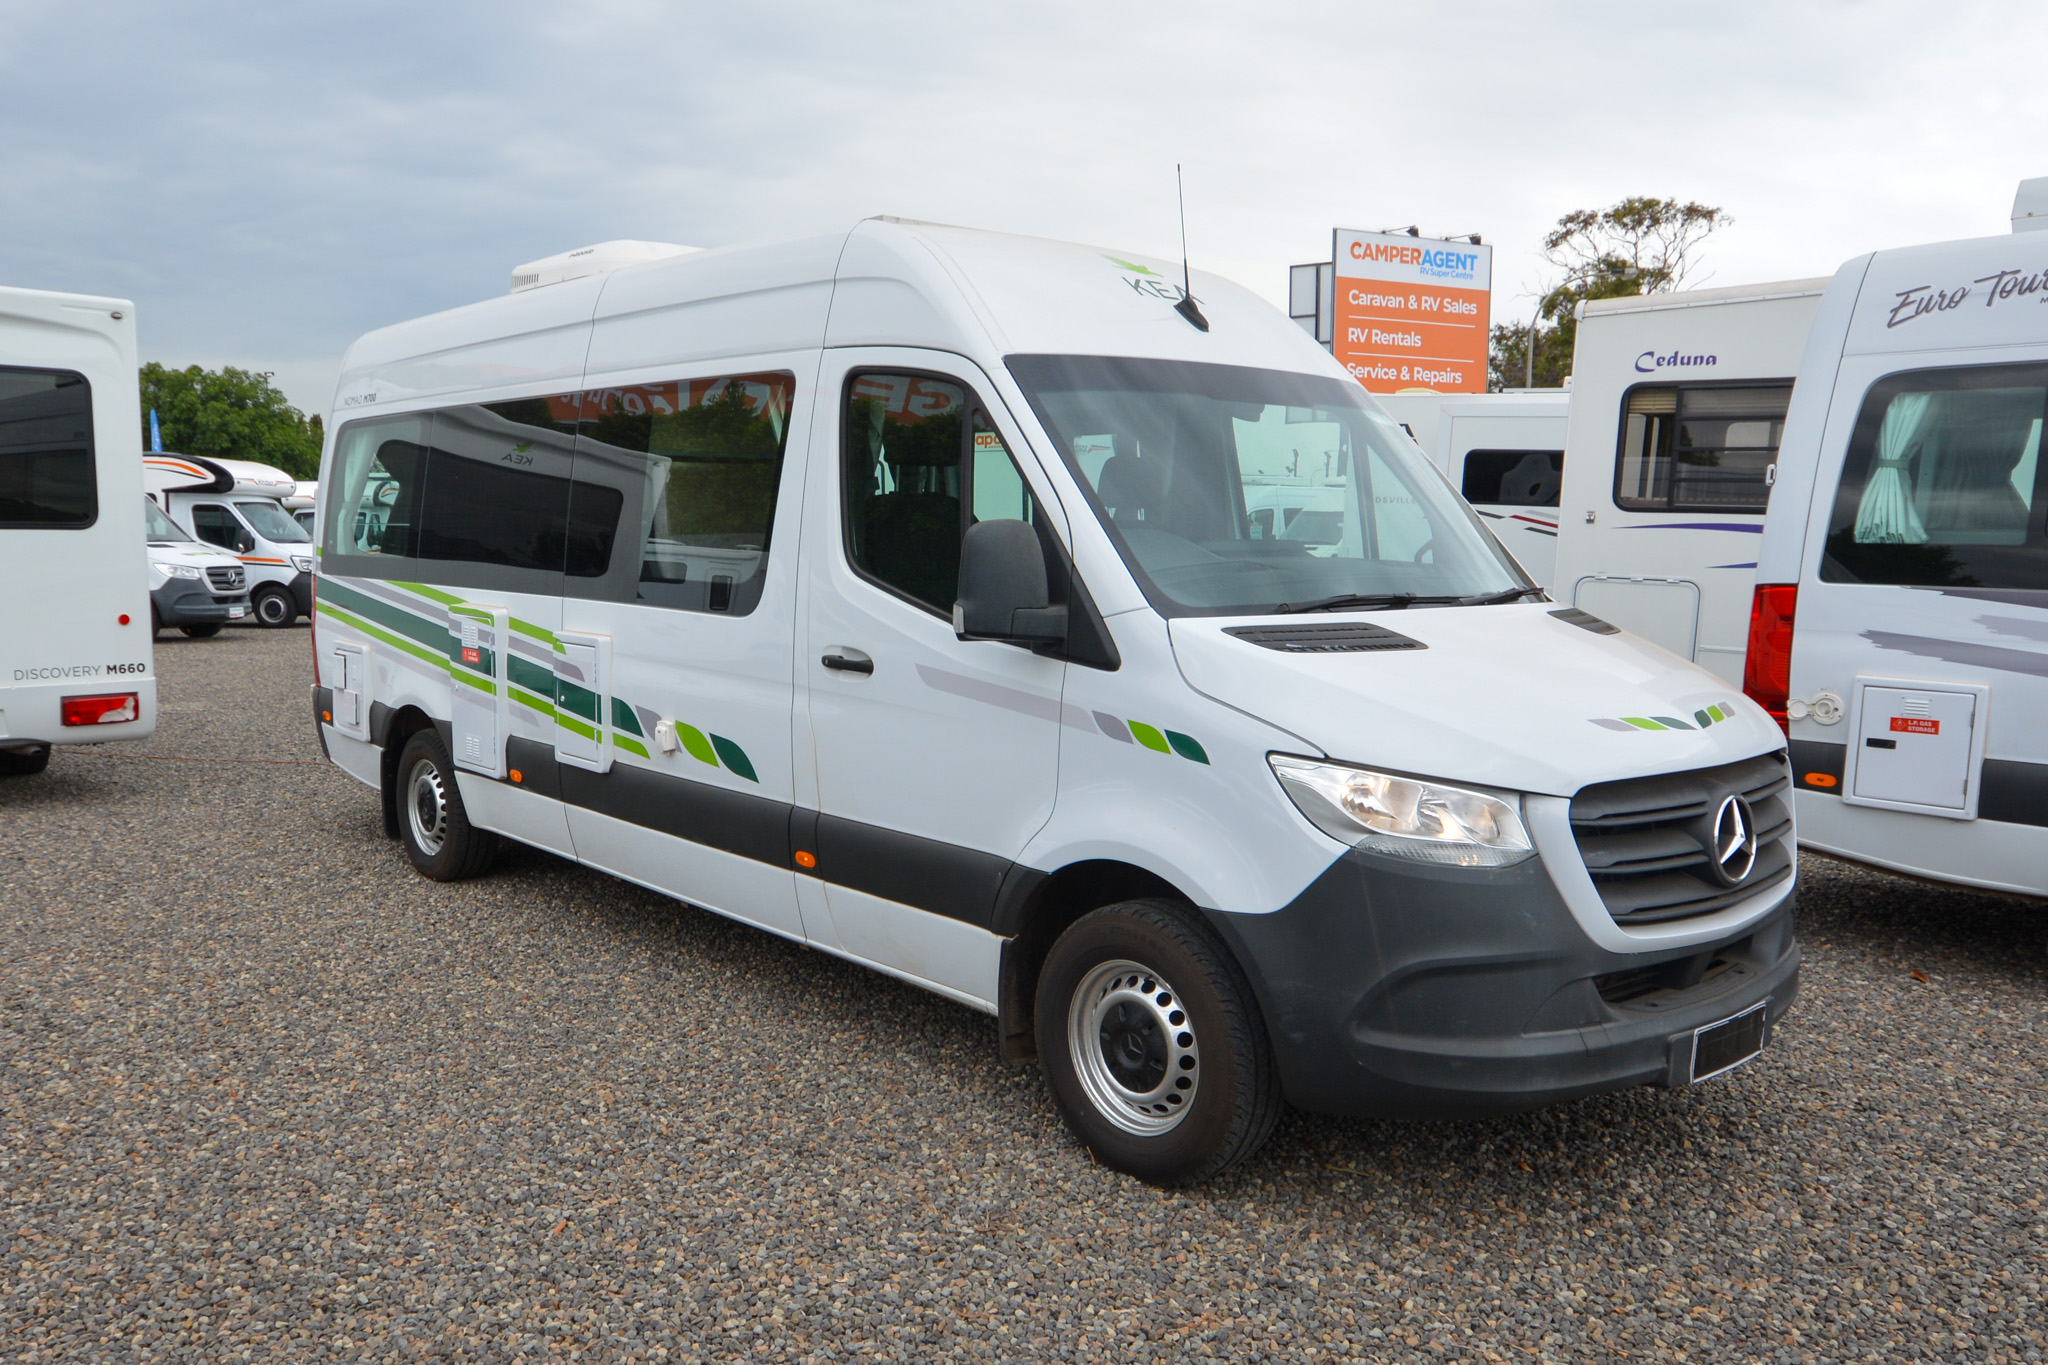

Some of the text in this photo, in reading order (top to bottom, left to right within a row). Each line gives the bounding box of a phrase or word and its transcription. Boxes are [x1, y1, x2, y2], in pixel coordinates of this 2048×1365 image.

[1350, 241, 1478, 271] CAMPERAGENT
[1420, 266, 1474, 280] RV Super Centre
[1348, 289, 1478, 315] Caravan & RV Sales
[1887, 285, 1971, 328] Euro
[1348, 327, 1422, 347] RV Rentals
[1634, 350, 1718, 373] Ceduna
[1346, 362, 1463, 386] Service & Repairs
[13, 662, 146, 681] DISCOVERY M660
